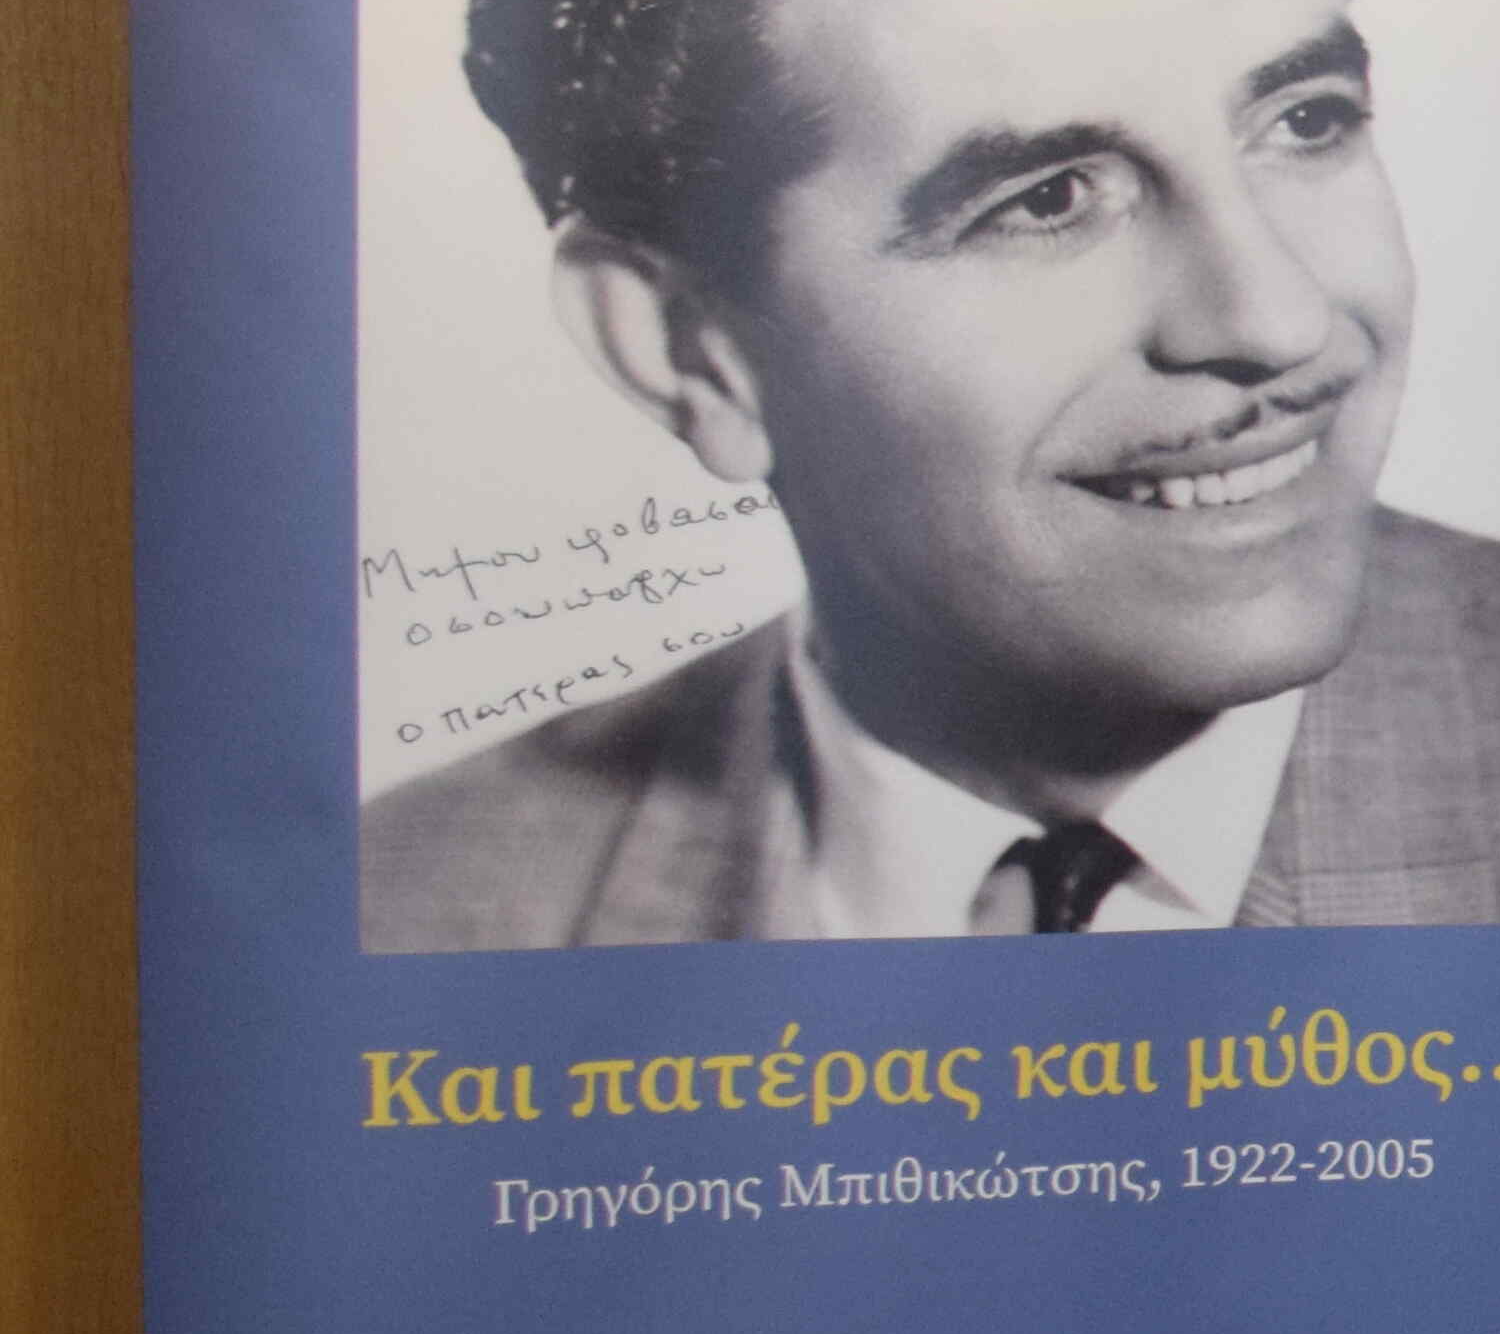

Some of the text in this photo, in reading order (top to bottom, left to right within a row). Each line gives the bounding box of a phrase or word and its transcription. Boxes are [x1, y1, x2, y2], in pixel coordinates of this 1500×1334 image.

[361, 1048, 542, 1128] Και
[568, 1021, 984, 1126] πατέρας
[1011, 1038, 1159, 1101] και
[493, 1137, 1436, 1234] Γρηγόρης Μπιθικώτσης, 1922-2005
